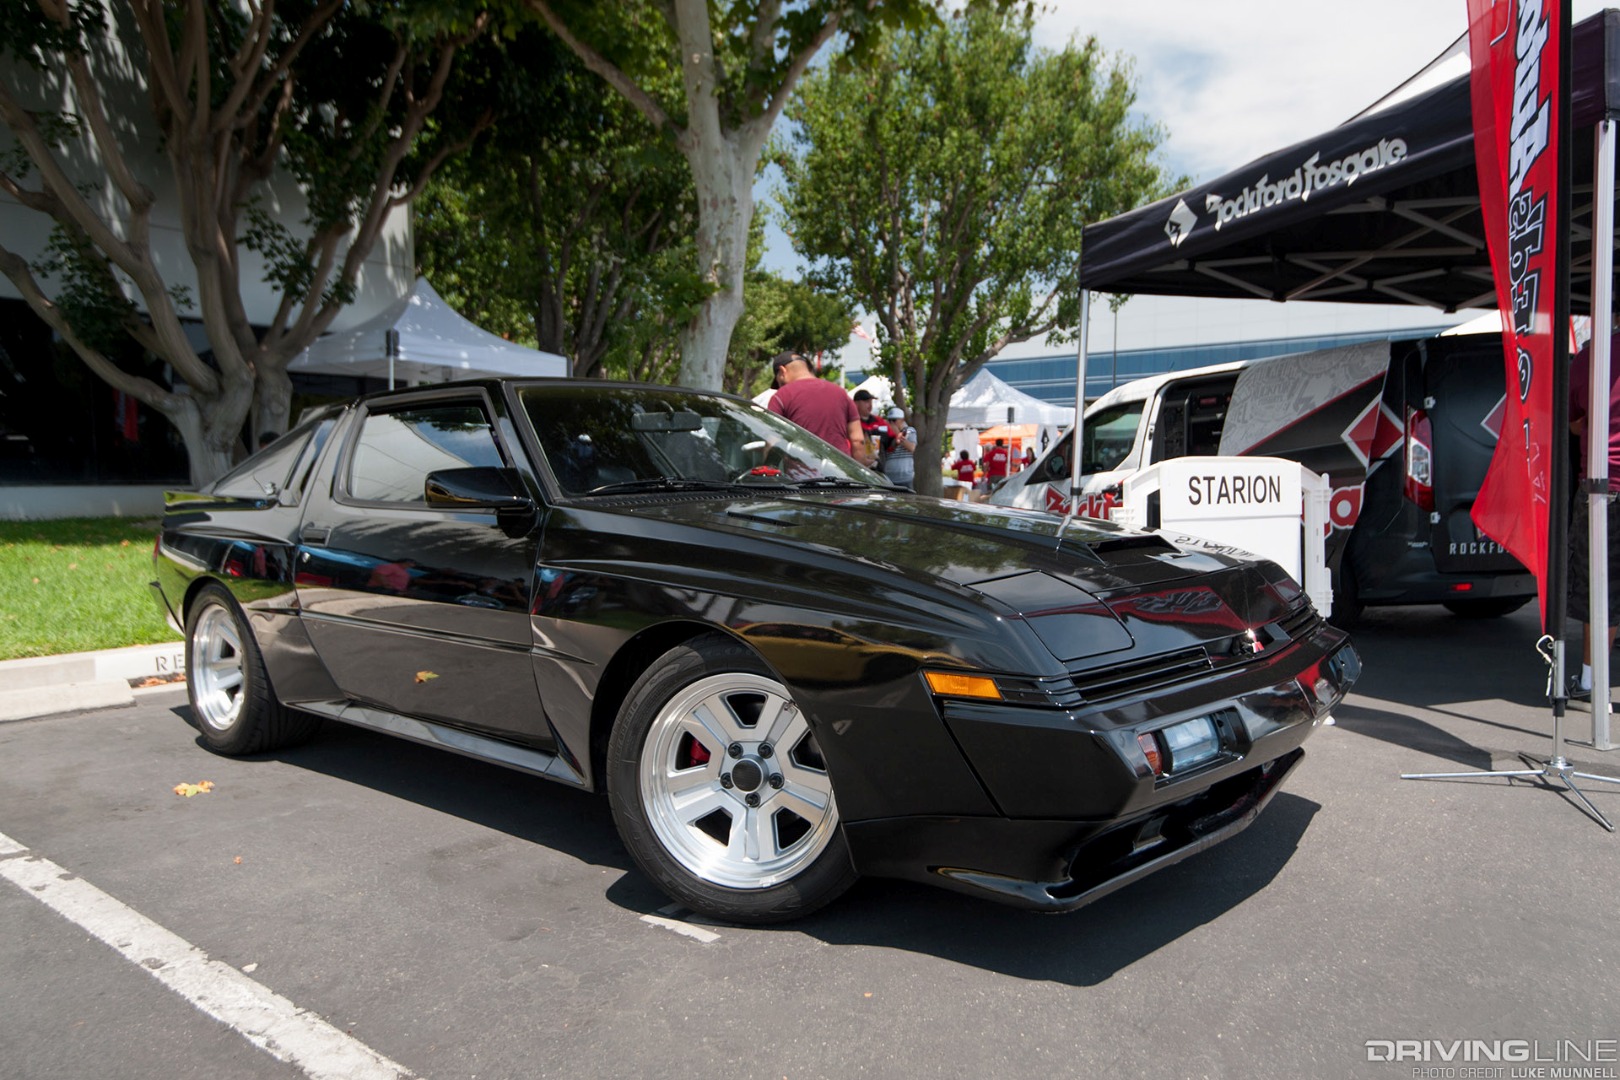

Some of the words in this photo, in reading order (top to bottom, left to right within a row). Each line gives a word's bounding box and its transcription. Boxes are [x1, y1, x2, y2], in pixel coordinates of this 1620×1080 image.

[1206, 167, 1303, 232] Rockford
[1188, 475, 1281, 506] STARION
[1449, 542, 1510, 555] ROCKFO
[155, 653, 186, 672] RE
